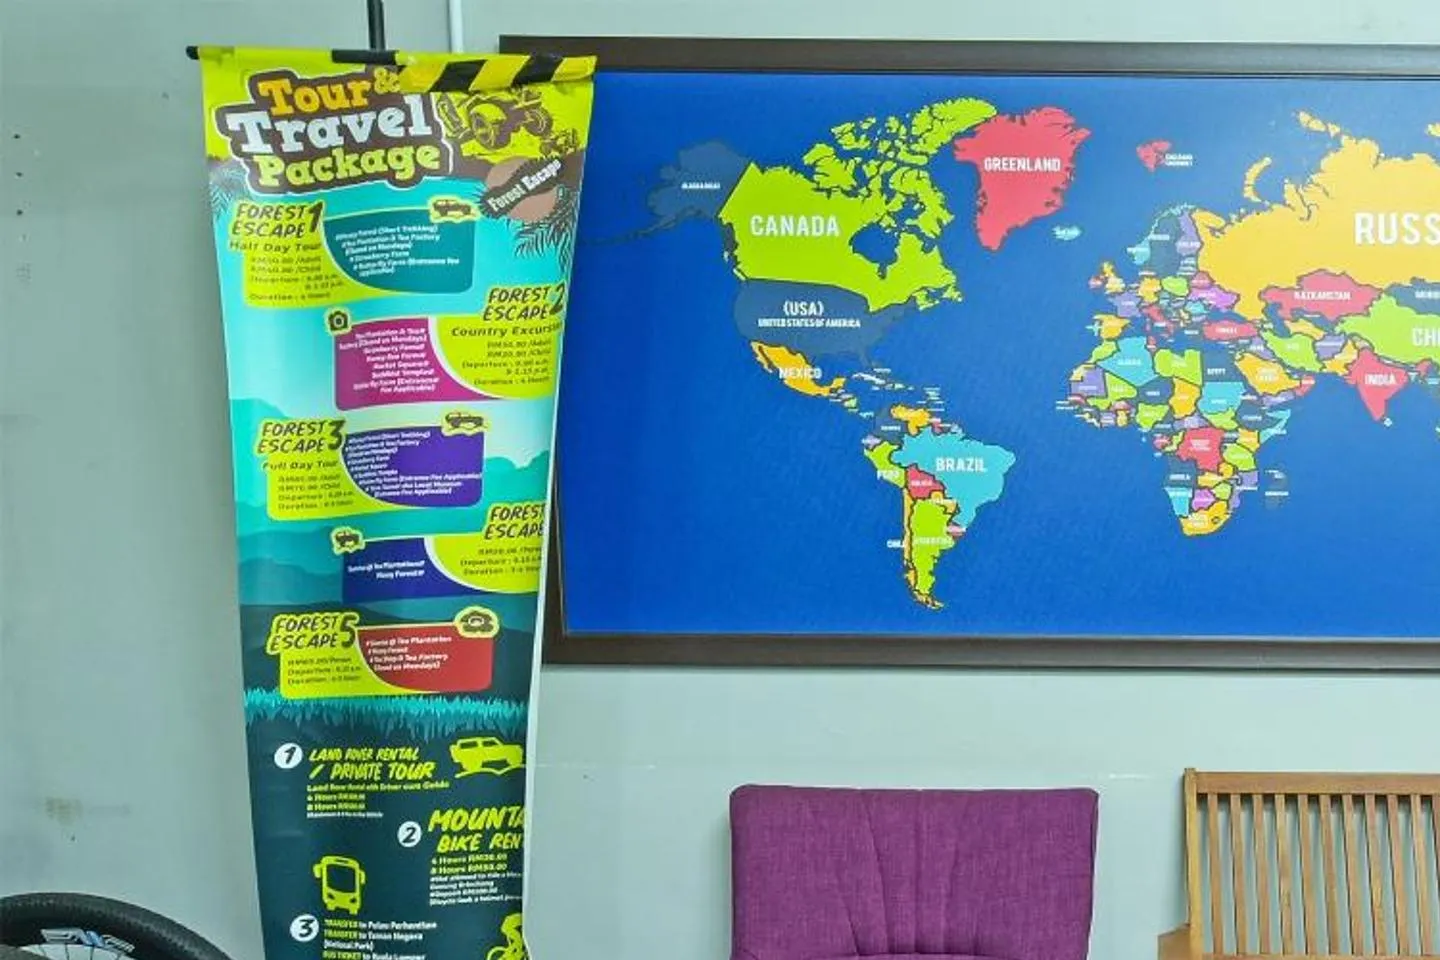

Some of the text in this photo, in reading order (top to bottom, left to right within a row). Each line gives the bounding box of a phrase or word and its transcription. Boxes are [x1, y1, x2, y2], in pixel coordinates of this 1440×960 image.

[258, 67, 400, 116] Tour &
[226, 94, 432, 154] Travel
[253, 145, 441, 186] Package
[984, 155, 1061, 172] GREENLAND
[237, 201, 323, 232] FOREST 1
[232, 220, 305, 239] ESCAPE
[750, 215, 840, 237] CANADA
[489, 283, 565, 315] FOREST 2
[783, 300, 824, 316] (USA)
[483, 303, 549, 321] ESCAPE
[451, 327, 508, 338] Country
[826, 319, 861, 328] AMERICA
[779, 366, 822, 380] MEXICO
[1364, 373, 1397, 385] INDIA
[263, 420, 328, 437] FOREST
[328, 419, 347, 450] 3
[257, 437, 326, 454] ESCAPE
[936, 457, 987, 472] BRAZIL
[276, 615, 339, 632] FOREST
[340, 614, 357, 648] 5
[270, 633, 339, 651] ESCAPE
[309, 748, 343, 761] LAND
[376, 747, 420, 761] RENTAL
[330, 761, 383, 780] PRIVATE
[388, 761, 435, 780] TOUR
[437, 833, 482, 853] BIKE
